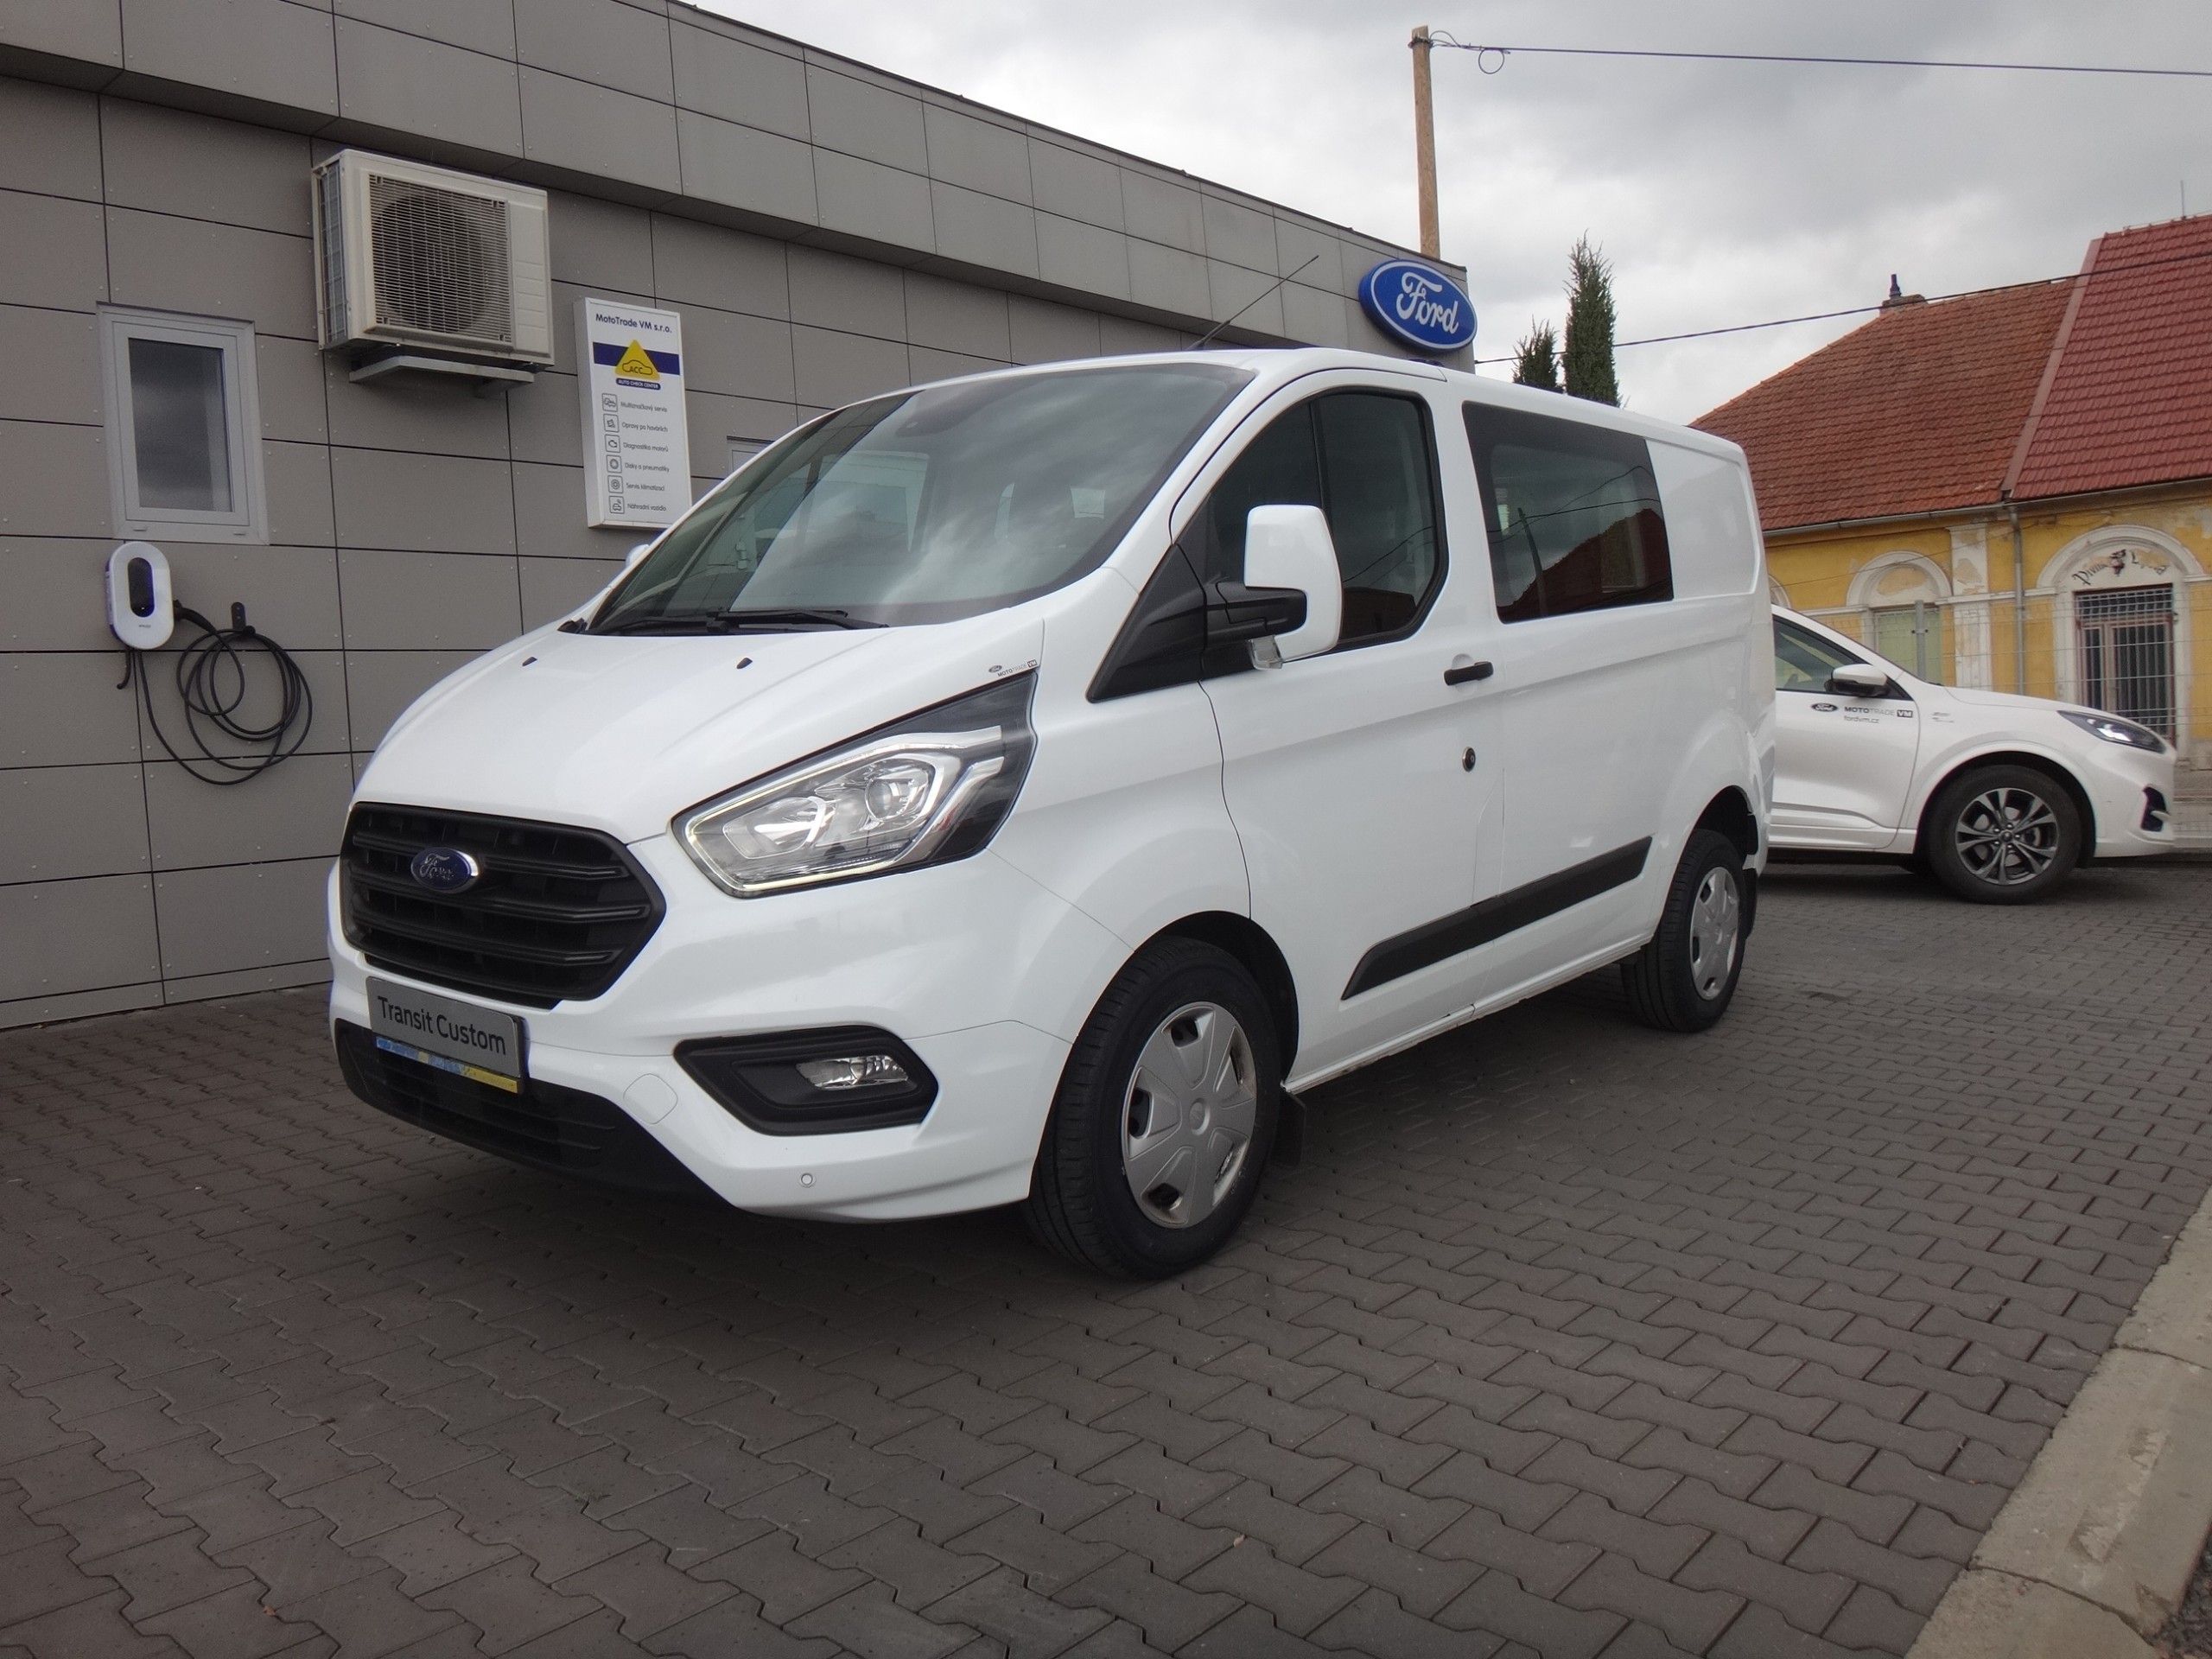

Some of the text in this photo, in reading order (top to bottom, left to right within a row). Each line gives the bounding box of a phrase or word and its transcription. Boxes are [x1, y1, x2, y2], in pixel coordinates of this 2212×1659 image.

[1396, 272, 1459, 334] Ford
[595, 314, 672, 334] MotoTrade VM s.r.o.
[629, 365, 643, 374] ACC
[419, 853, 454, 880] Ford
[378, 996, 506, 1055] Transit Custom
